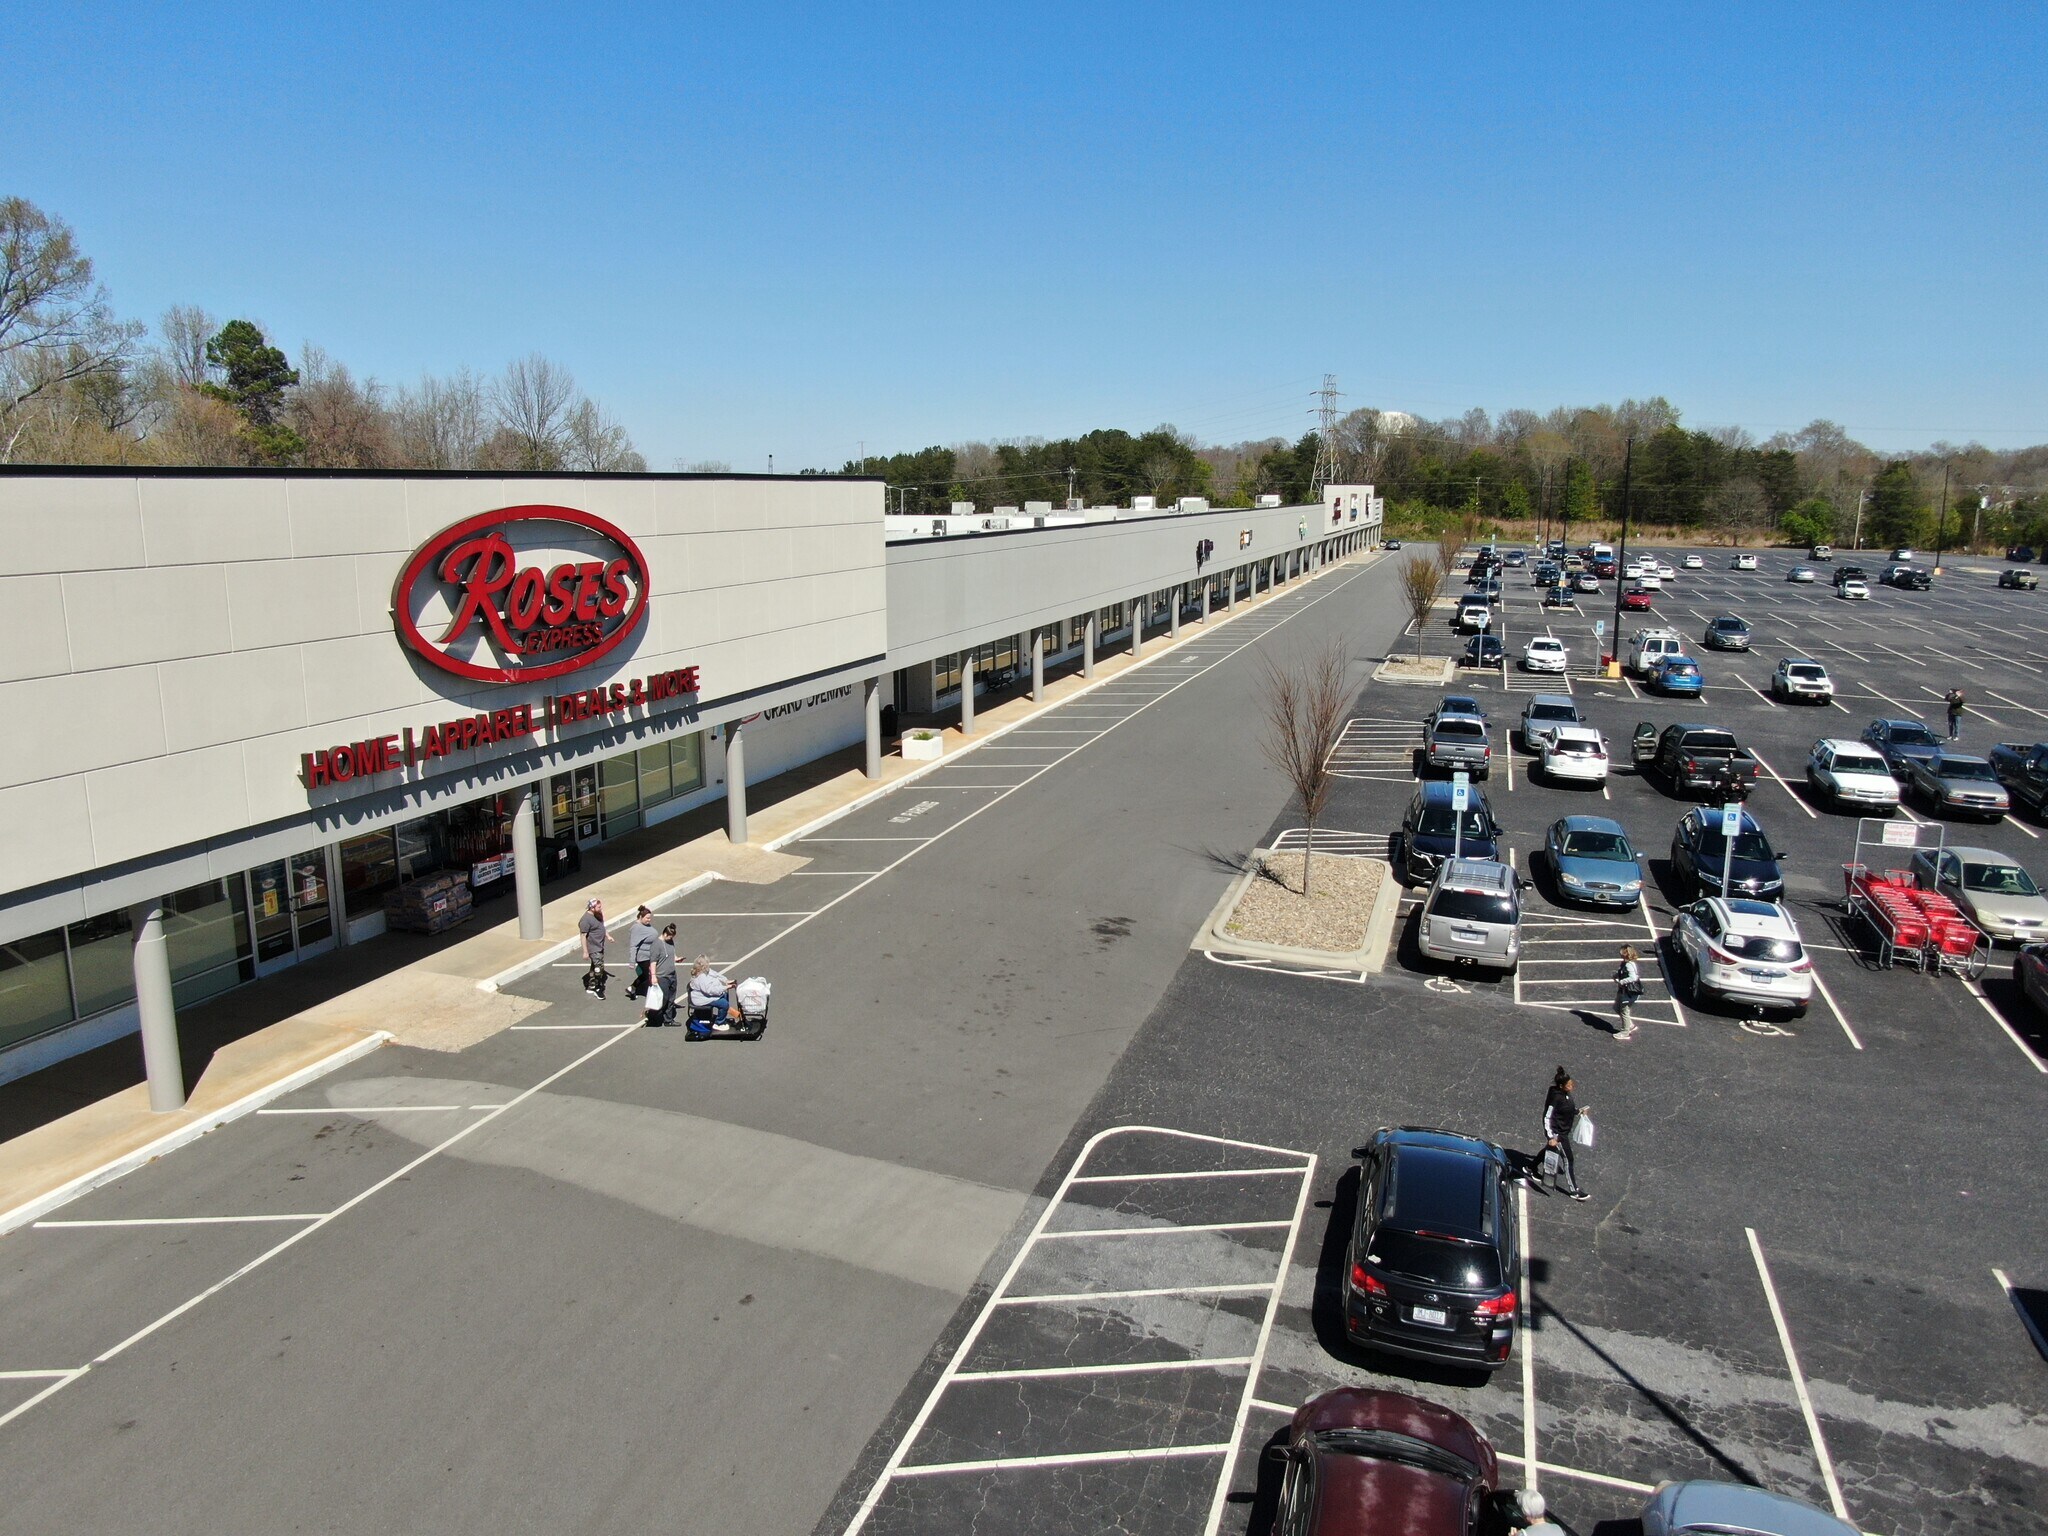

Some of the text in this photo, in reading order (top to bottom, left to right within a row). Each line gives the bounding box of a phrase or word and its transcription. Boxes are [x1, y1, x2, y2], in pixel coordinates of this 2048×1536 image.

[433, 532, 630, 654] ROSES
[525, 622, 603, 654] EXPRESS
[302, 734, 402, 790] HOME
[422, 704, 540, 761] APPAREL
[556, 684, 627, 726] DEALS
[631, 679, 647, 707] &
[648, 666, 701, 700] MORE
